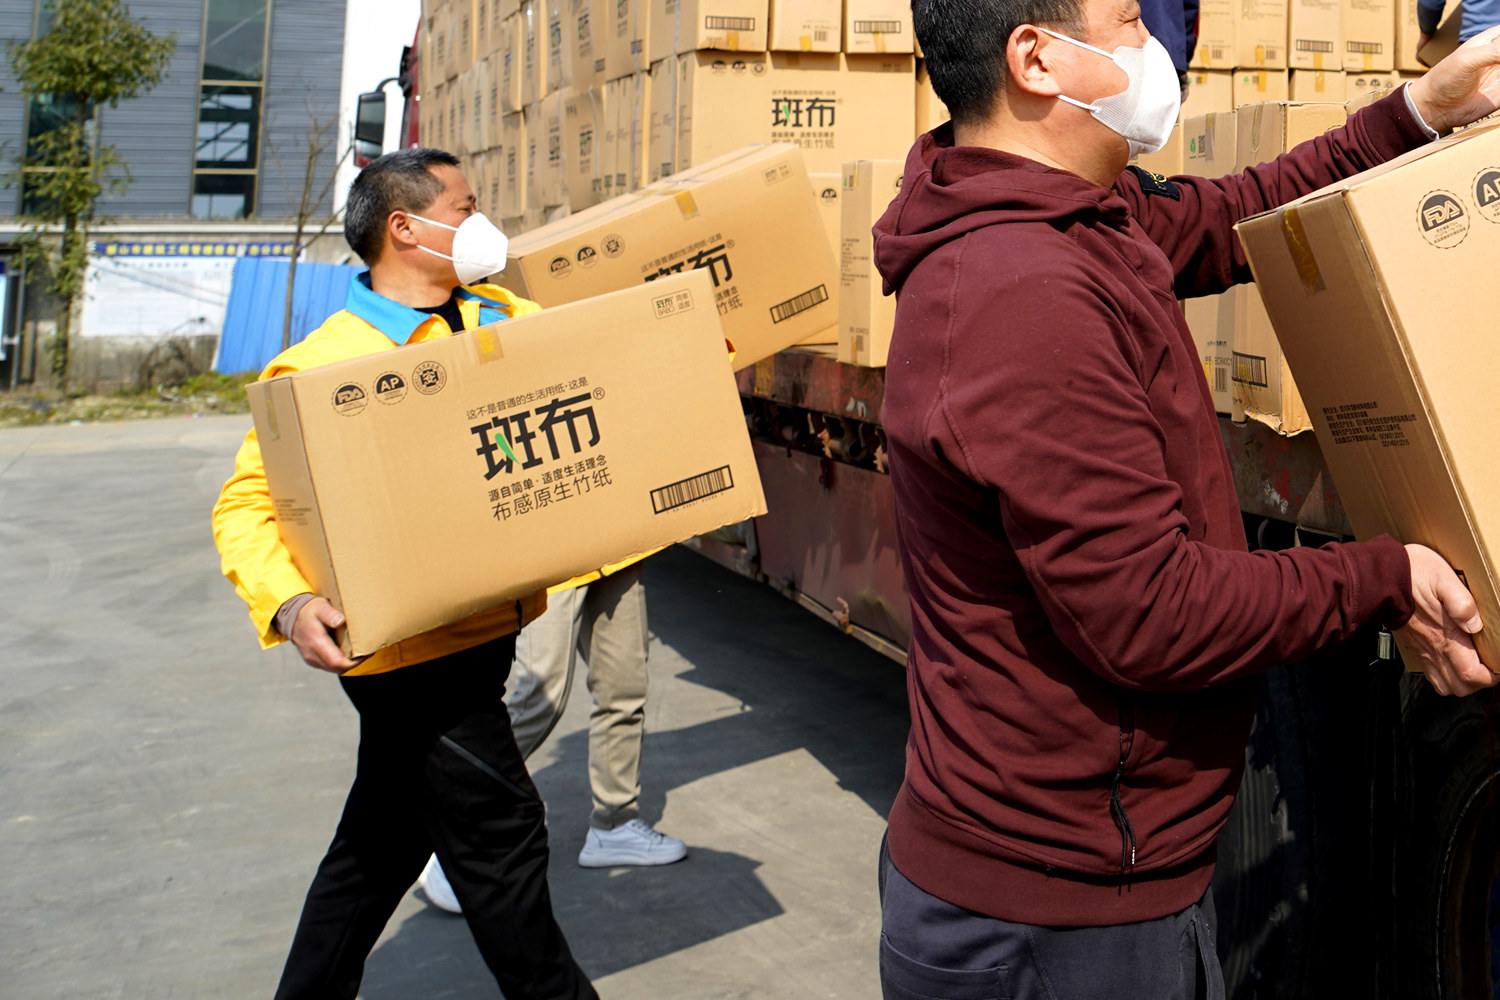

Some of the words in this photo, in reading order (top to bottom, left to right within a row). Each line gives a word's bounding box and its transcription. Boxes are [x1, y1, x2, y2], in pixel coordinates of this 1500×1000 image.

[772, 97, 836, 127] 斑布
[1423, 200, 1461, 227] FDA
[644, 244, 732, 287] 布
[380, 377, 401, 392] AP
[466, 376, 589, 422] 这不是普通的生活用纸·这是
[471, 391, 602, 481] 斑布
[492, 468, 612, 522] 布感原生竹纸
